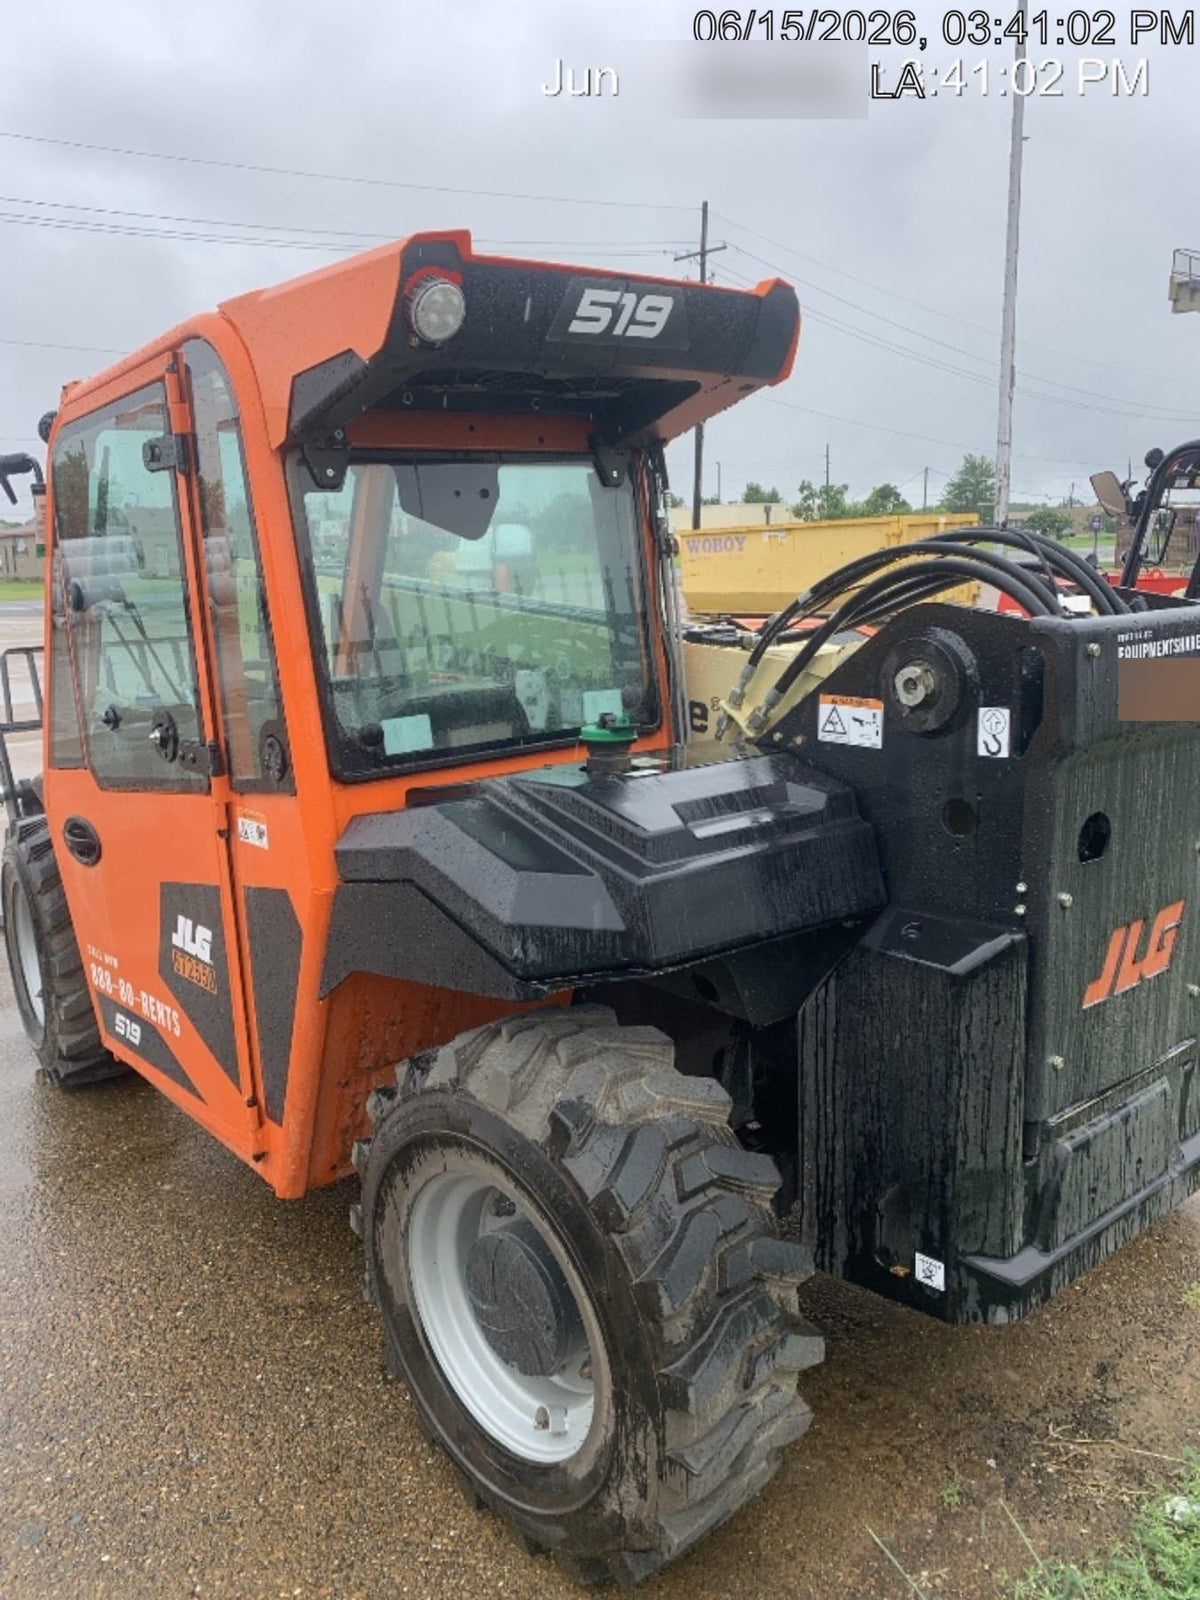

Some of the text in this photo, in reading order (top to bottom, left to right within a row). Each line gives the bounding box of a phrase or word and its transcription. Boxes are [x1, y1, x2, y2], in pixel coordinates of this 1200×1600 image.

[568, 288, 675, 339] 519
[172, 914, 214, 966] JLG
[1082, 898, 1186, 1010] JLG
[115, 1012, 142, 1046] 519
